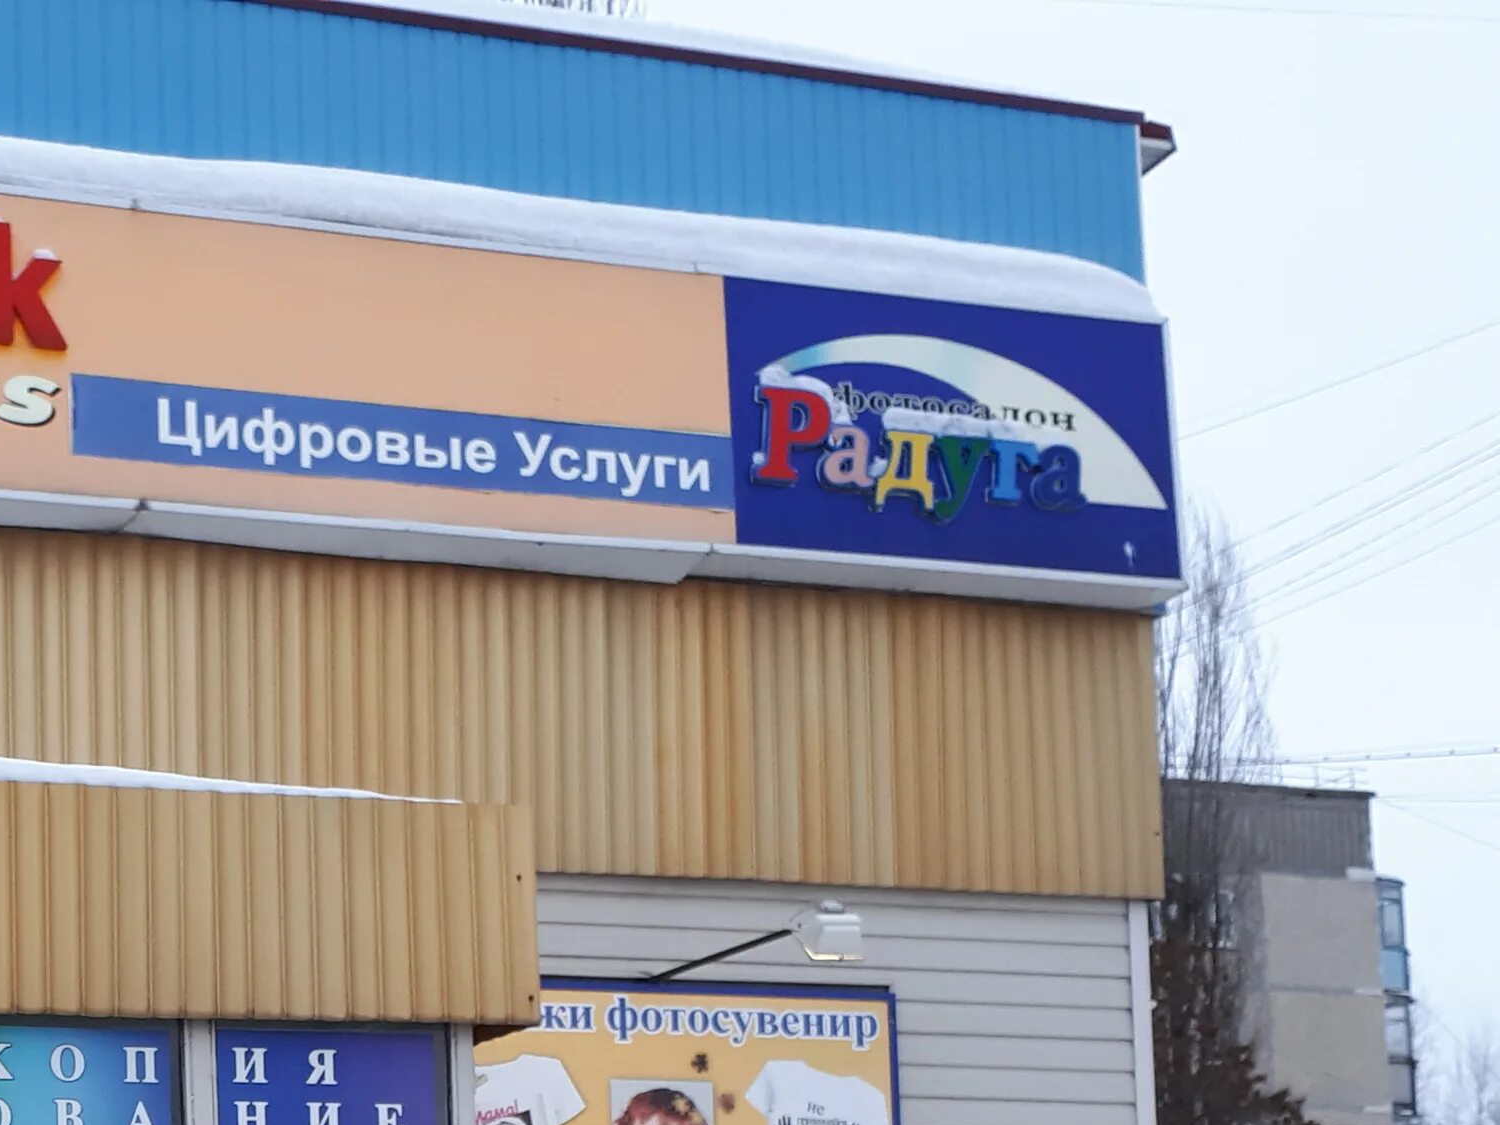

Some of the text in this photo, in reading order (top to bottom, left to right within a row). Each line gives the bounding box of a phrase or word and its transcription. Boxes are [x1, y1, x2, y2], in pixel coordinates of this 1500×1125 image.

[155, 396, 712, 497] Цифровые Услуги
[751, 382, 1090, 525] Радуга
[605, 996, 879, 1051] фотосувенир
